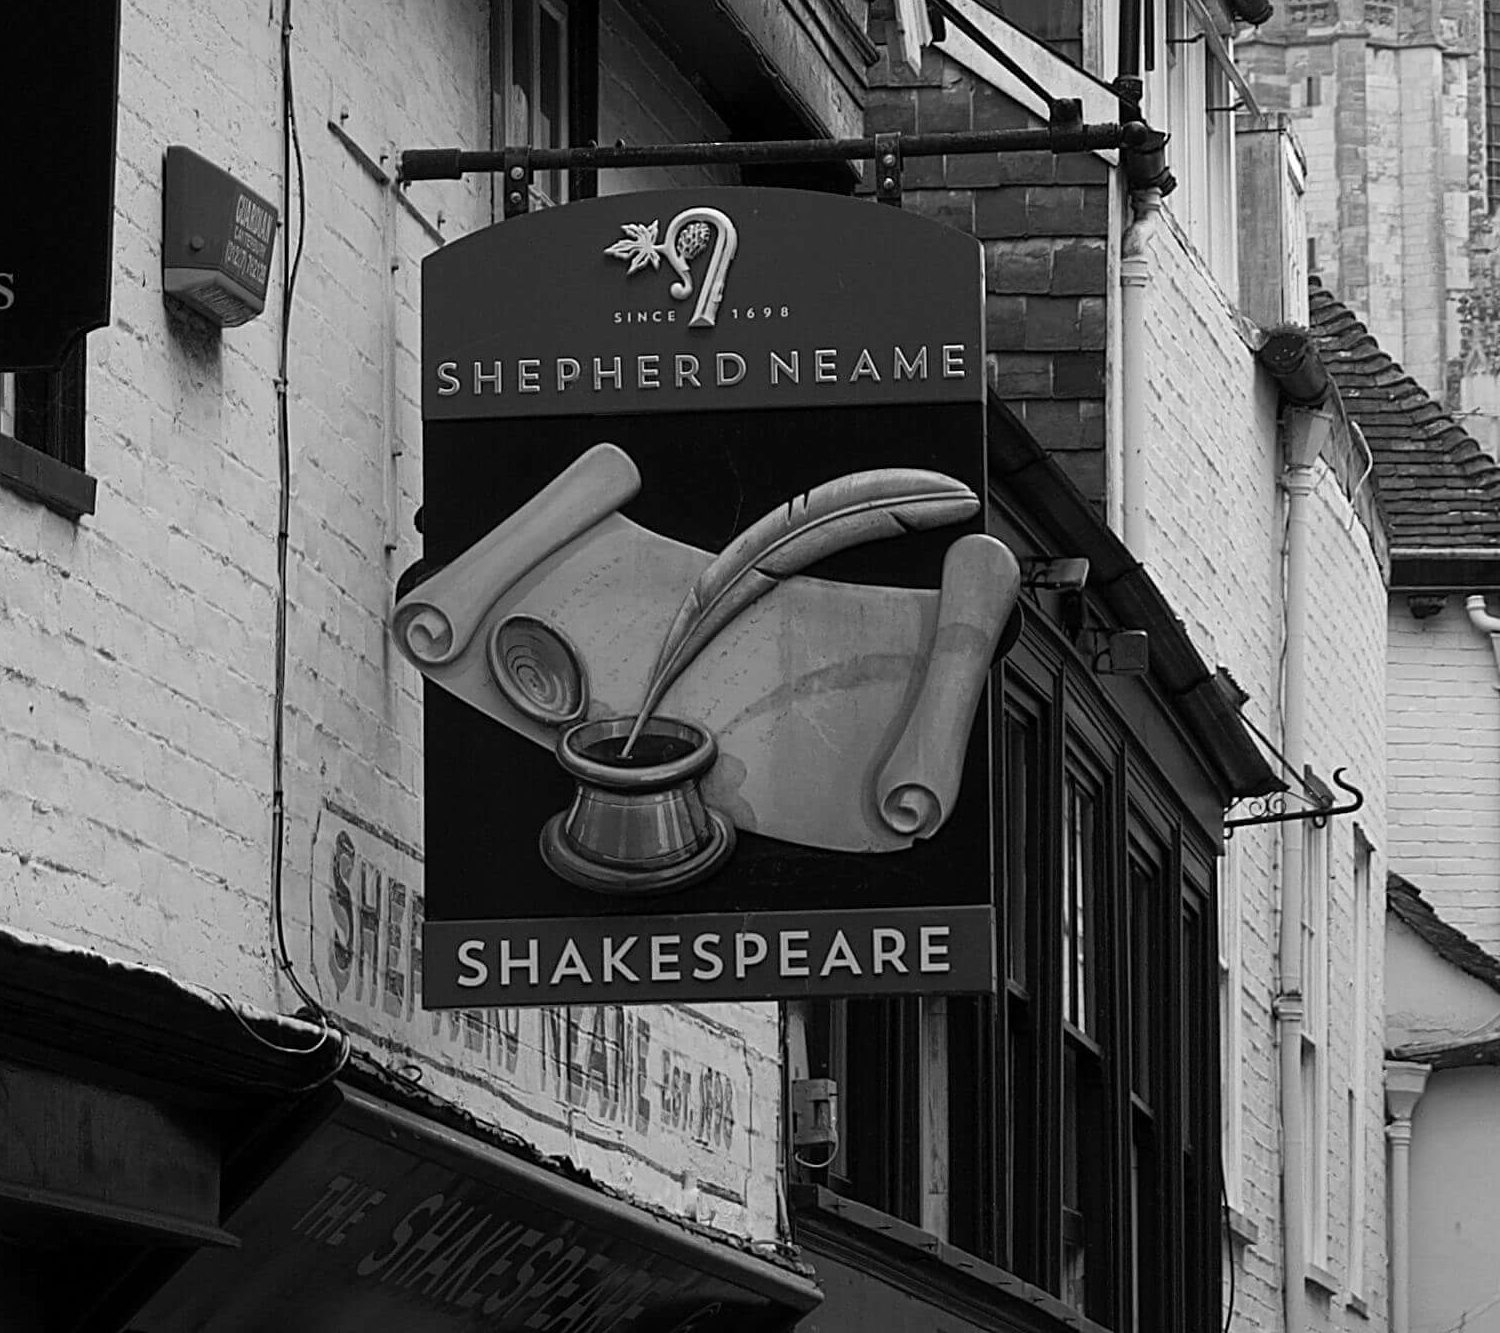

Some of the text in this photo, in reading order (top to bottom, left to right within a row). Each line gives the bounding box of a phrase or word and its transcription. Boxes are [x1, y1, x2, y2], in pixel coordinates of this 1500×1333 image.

[614, 306, 790, 324] SINCE 1698
[437, 344, 968, 396] SHEPHERD NEAME
[457, 926, 952, 987] SHAKESPEARE
[291, 1173, 673, 1333] THE SHAKESPEARE
